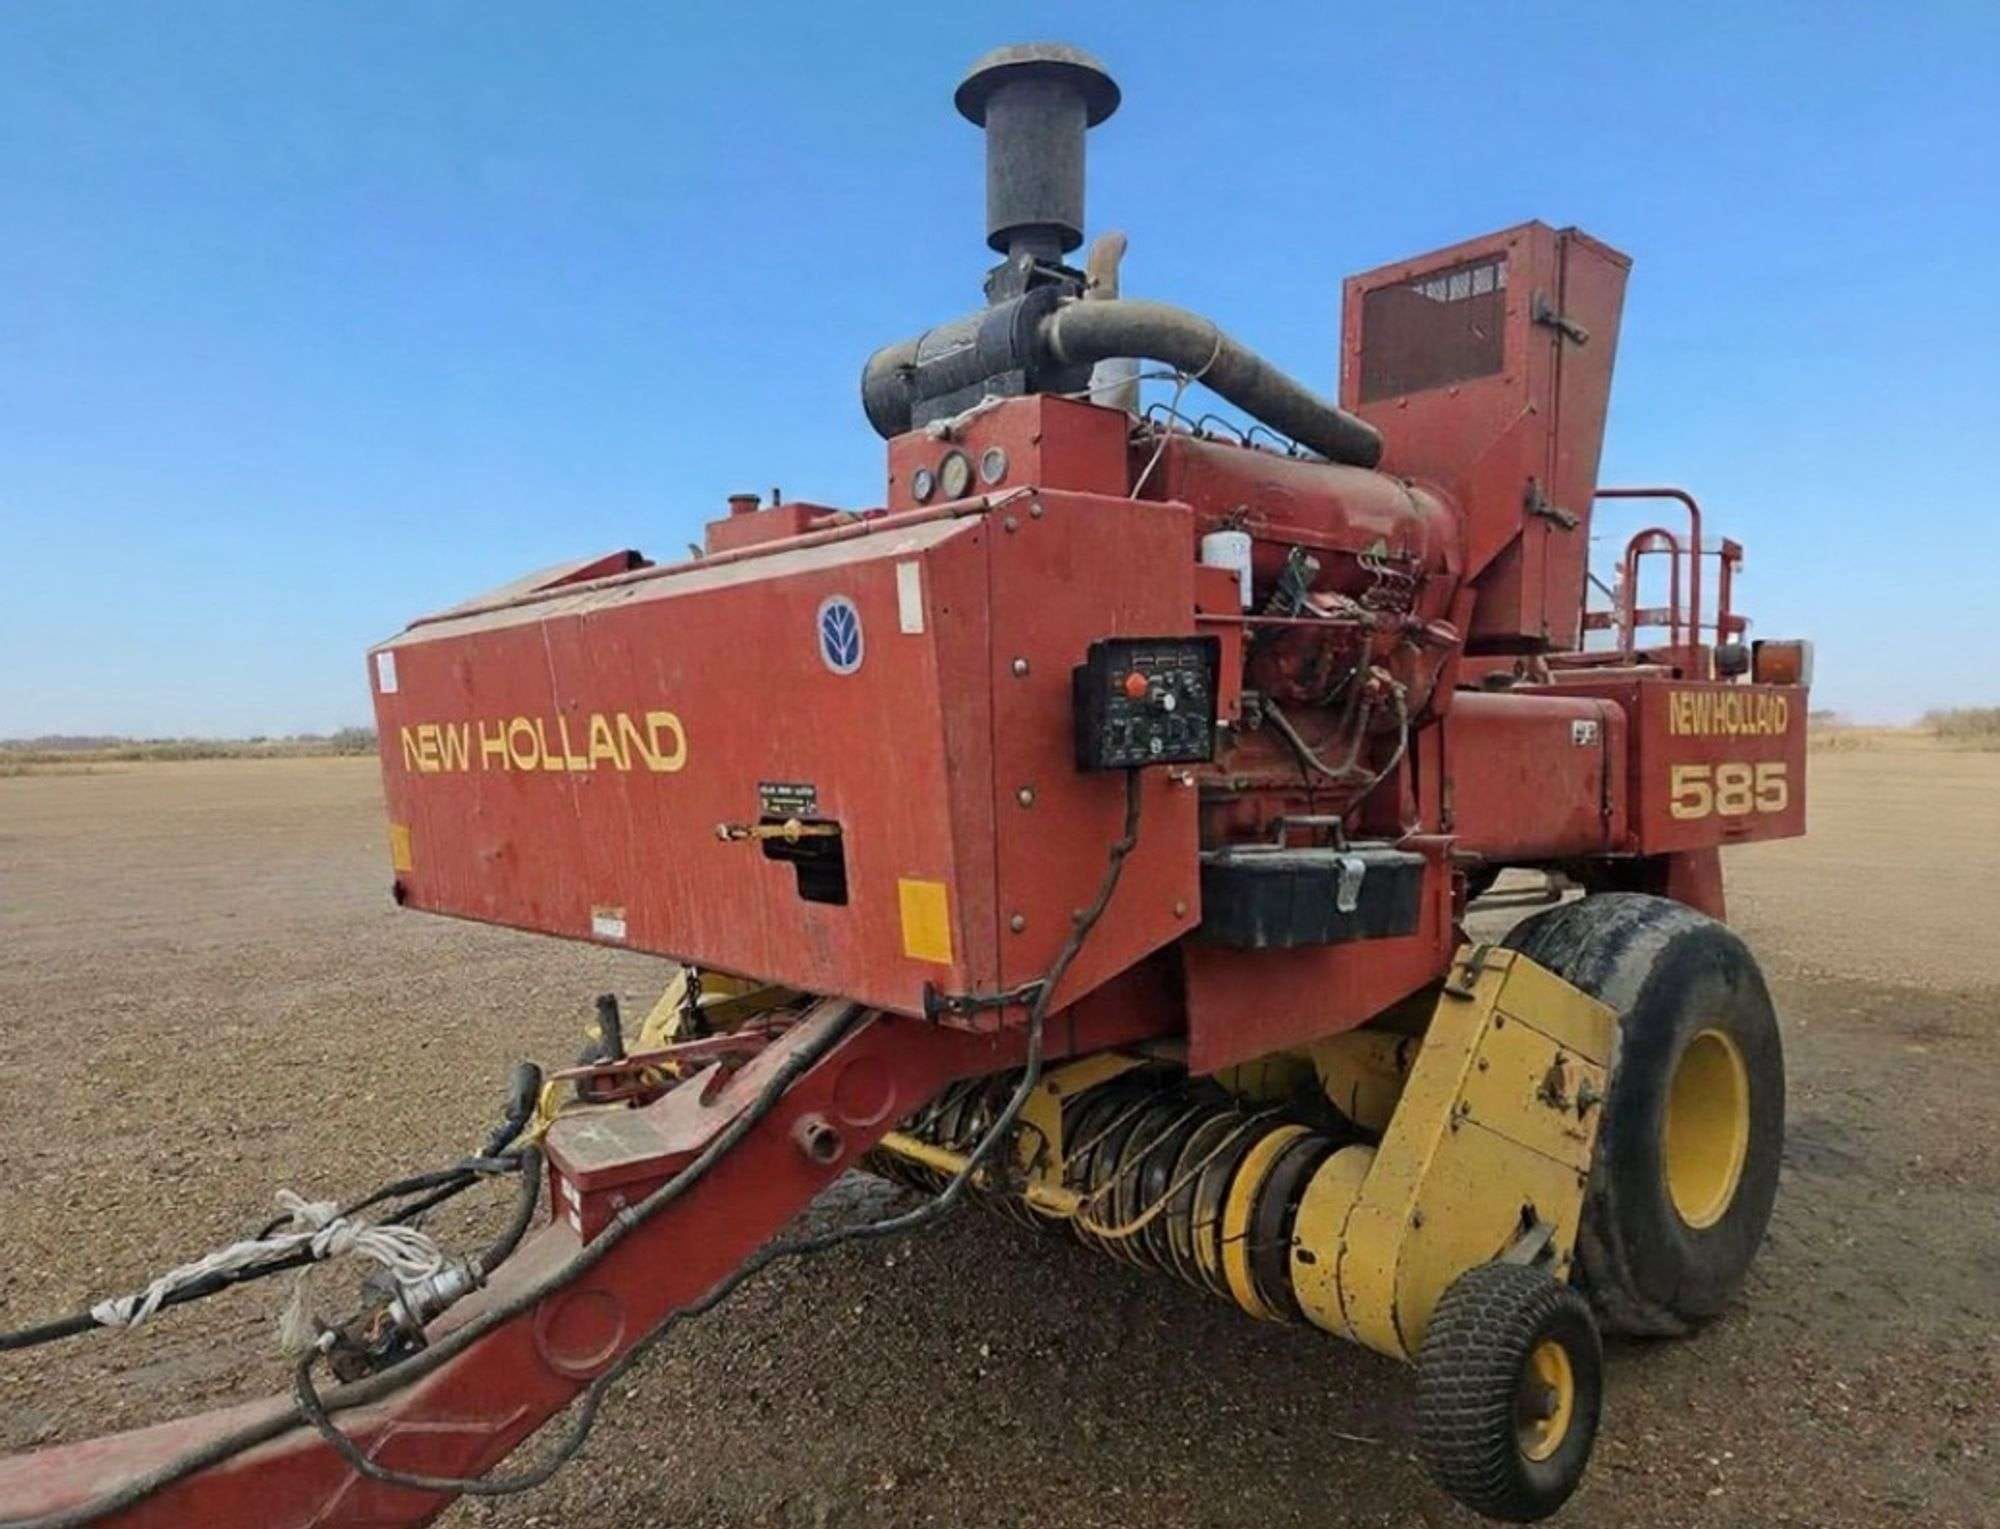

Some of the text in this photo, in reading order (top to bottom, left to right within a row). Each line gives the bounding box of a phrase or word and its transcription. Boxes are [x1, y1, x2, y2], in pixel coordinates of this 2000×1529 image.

[401, 711, 688, 773] NEW HOLLAND
[1669, 691, 1788, 735] NEW HOLLAND
[1669, 762, 1789, 820] 585
